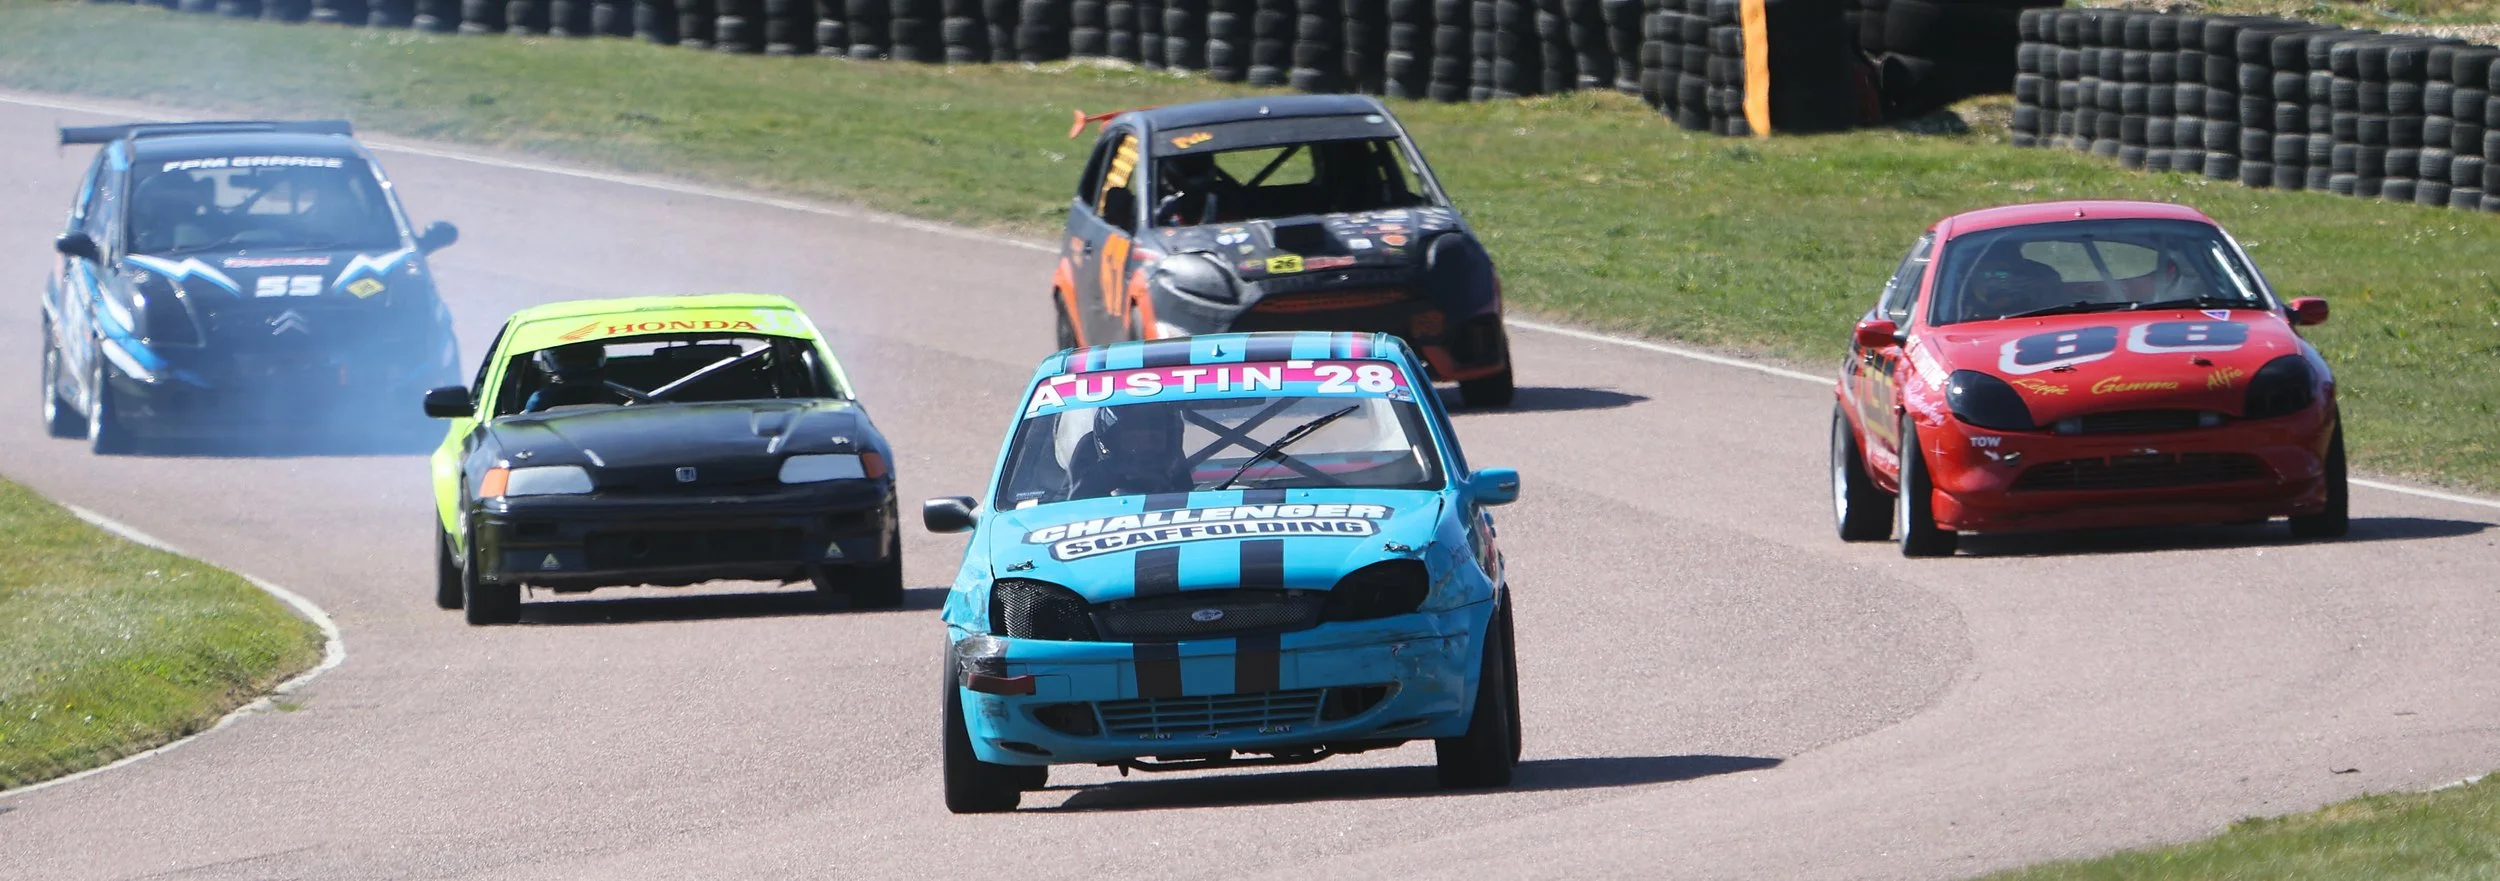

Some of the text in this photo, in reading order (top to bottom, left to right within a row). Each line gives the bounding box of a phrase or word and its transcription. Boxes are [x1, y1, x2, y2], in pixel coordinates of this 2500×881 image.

[231, 156, 343, 168] GARAGE
[255, 275, 323, 298] 55
[607, 309, 804, 336] HONDA 33
[1998, 320, 2249, 375] 88
[1026, 364, 1397, 414] AUSTIN 28
[2091, 375, 2178, 395] Gemma
[1969, 436, 2002, 447] TOW
[1029, 503, 1390, 543] CHALLENGER
[1065, 521, 1364, 556] SCAFFOLDING
